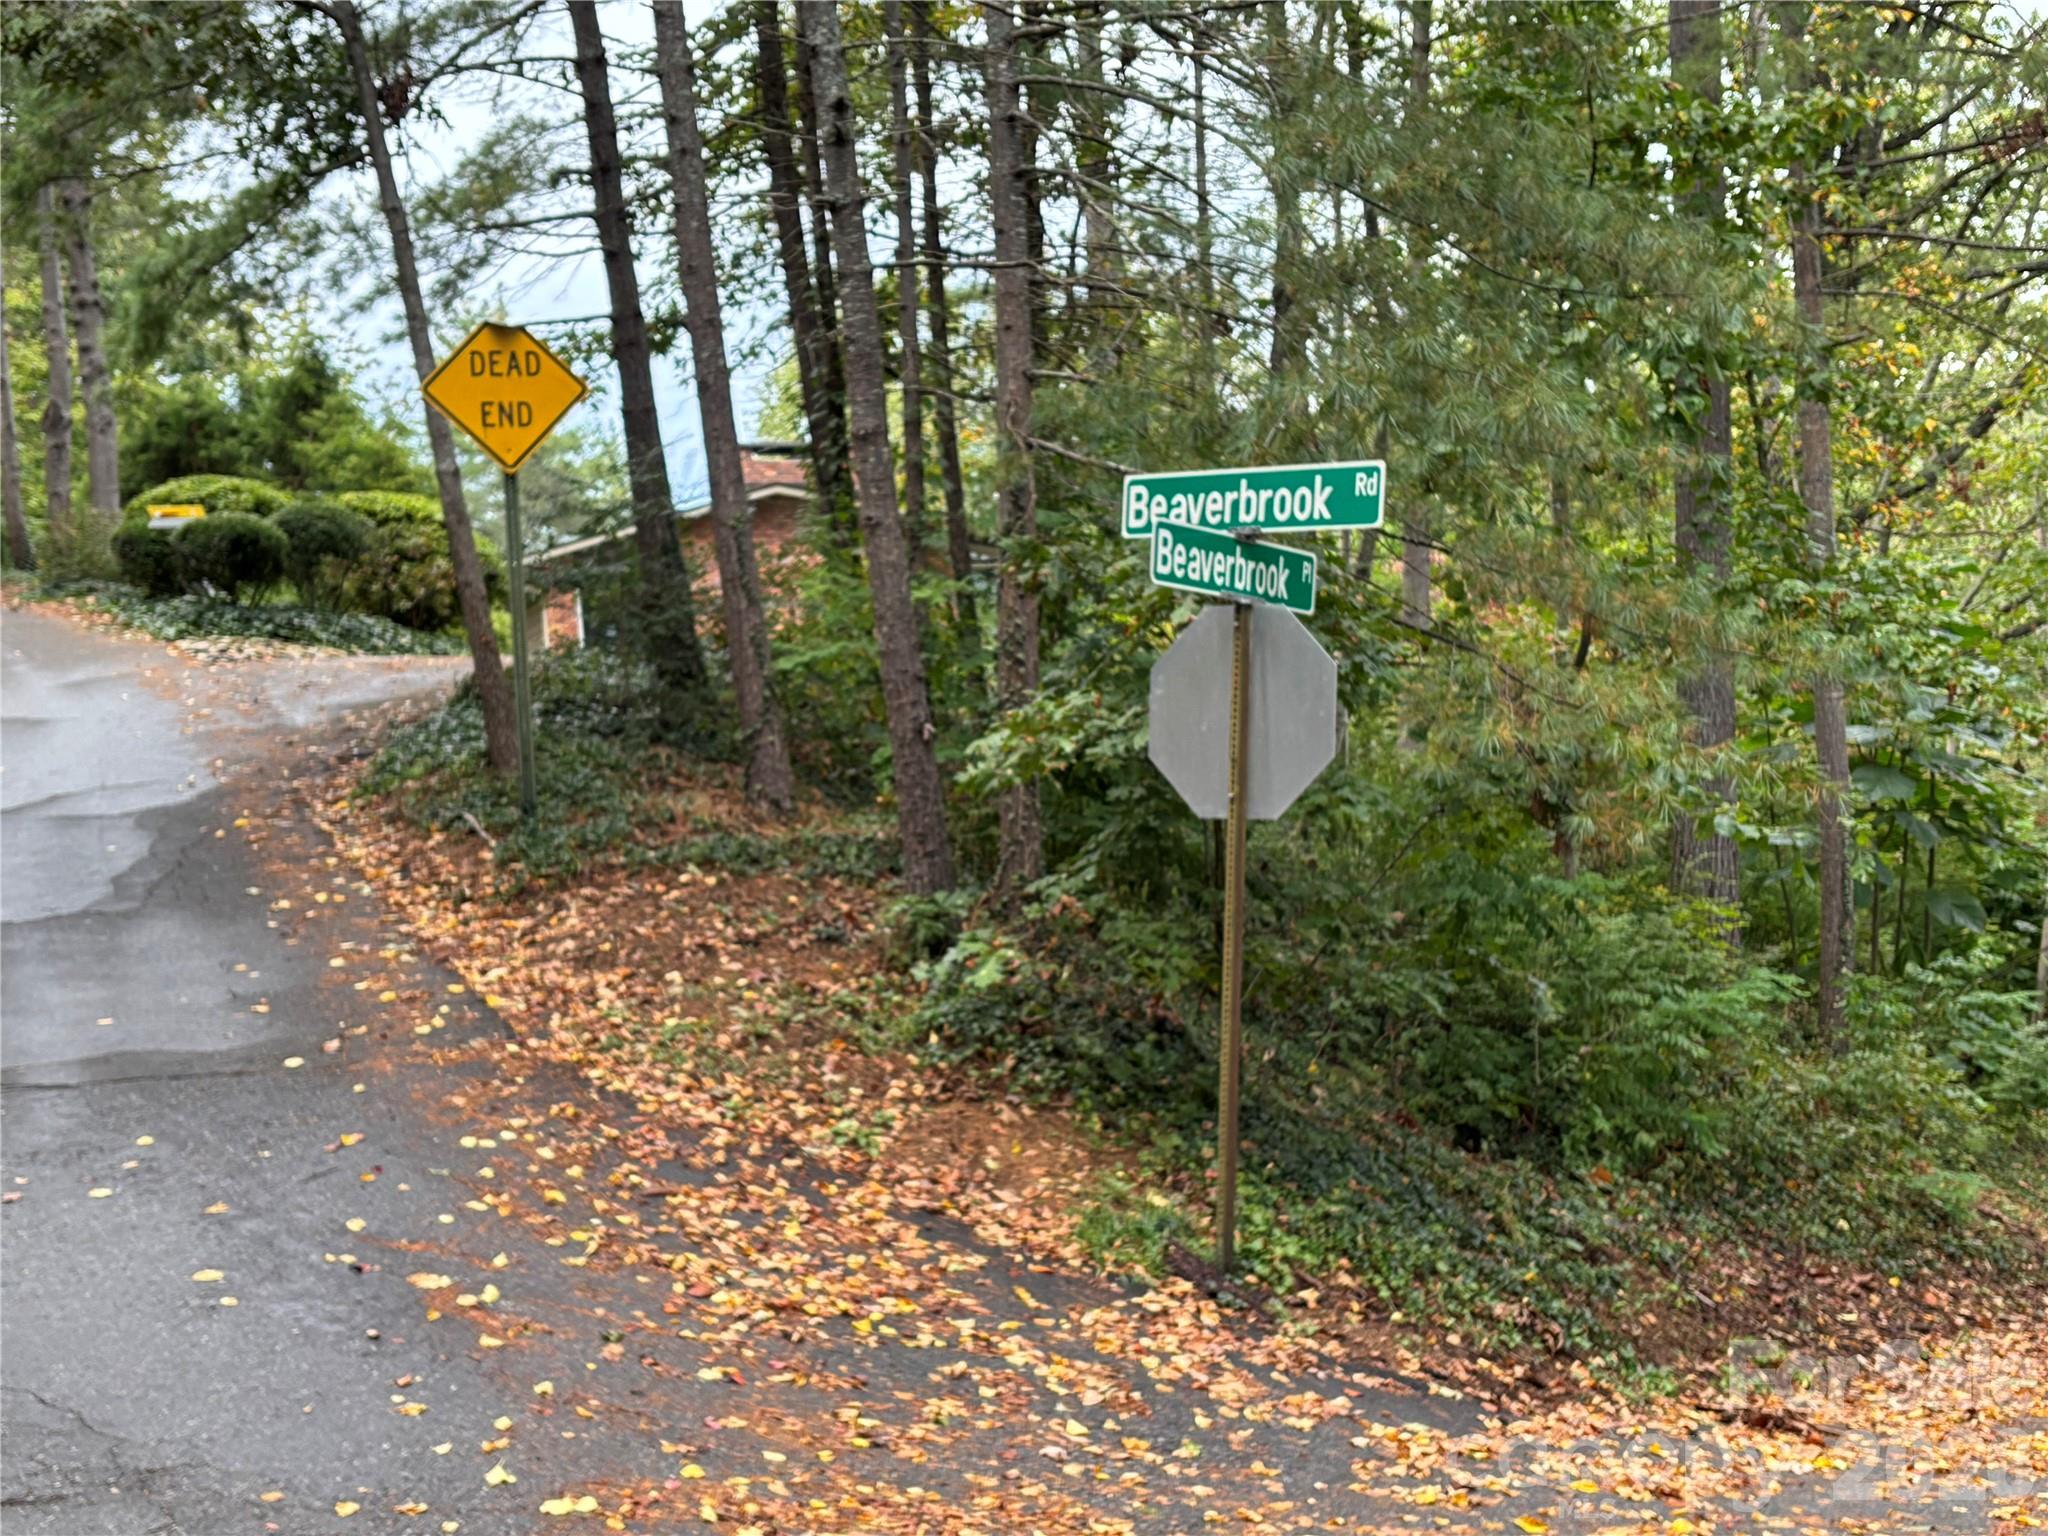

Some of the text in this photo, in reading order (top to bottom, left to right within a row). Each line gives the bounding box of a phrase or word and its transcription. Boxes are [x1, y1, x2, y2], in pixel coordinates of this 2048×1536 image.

[470, 350, 541, 377] DEAD
[481, 401, 533, 428] END
[1127, 471, 1378, 529] Beaverbrook Rd
[1155, 528, 1312, 600] Beaverbrook Pl
